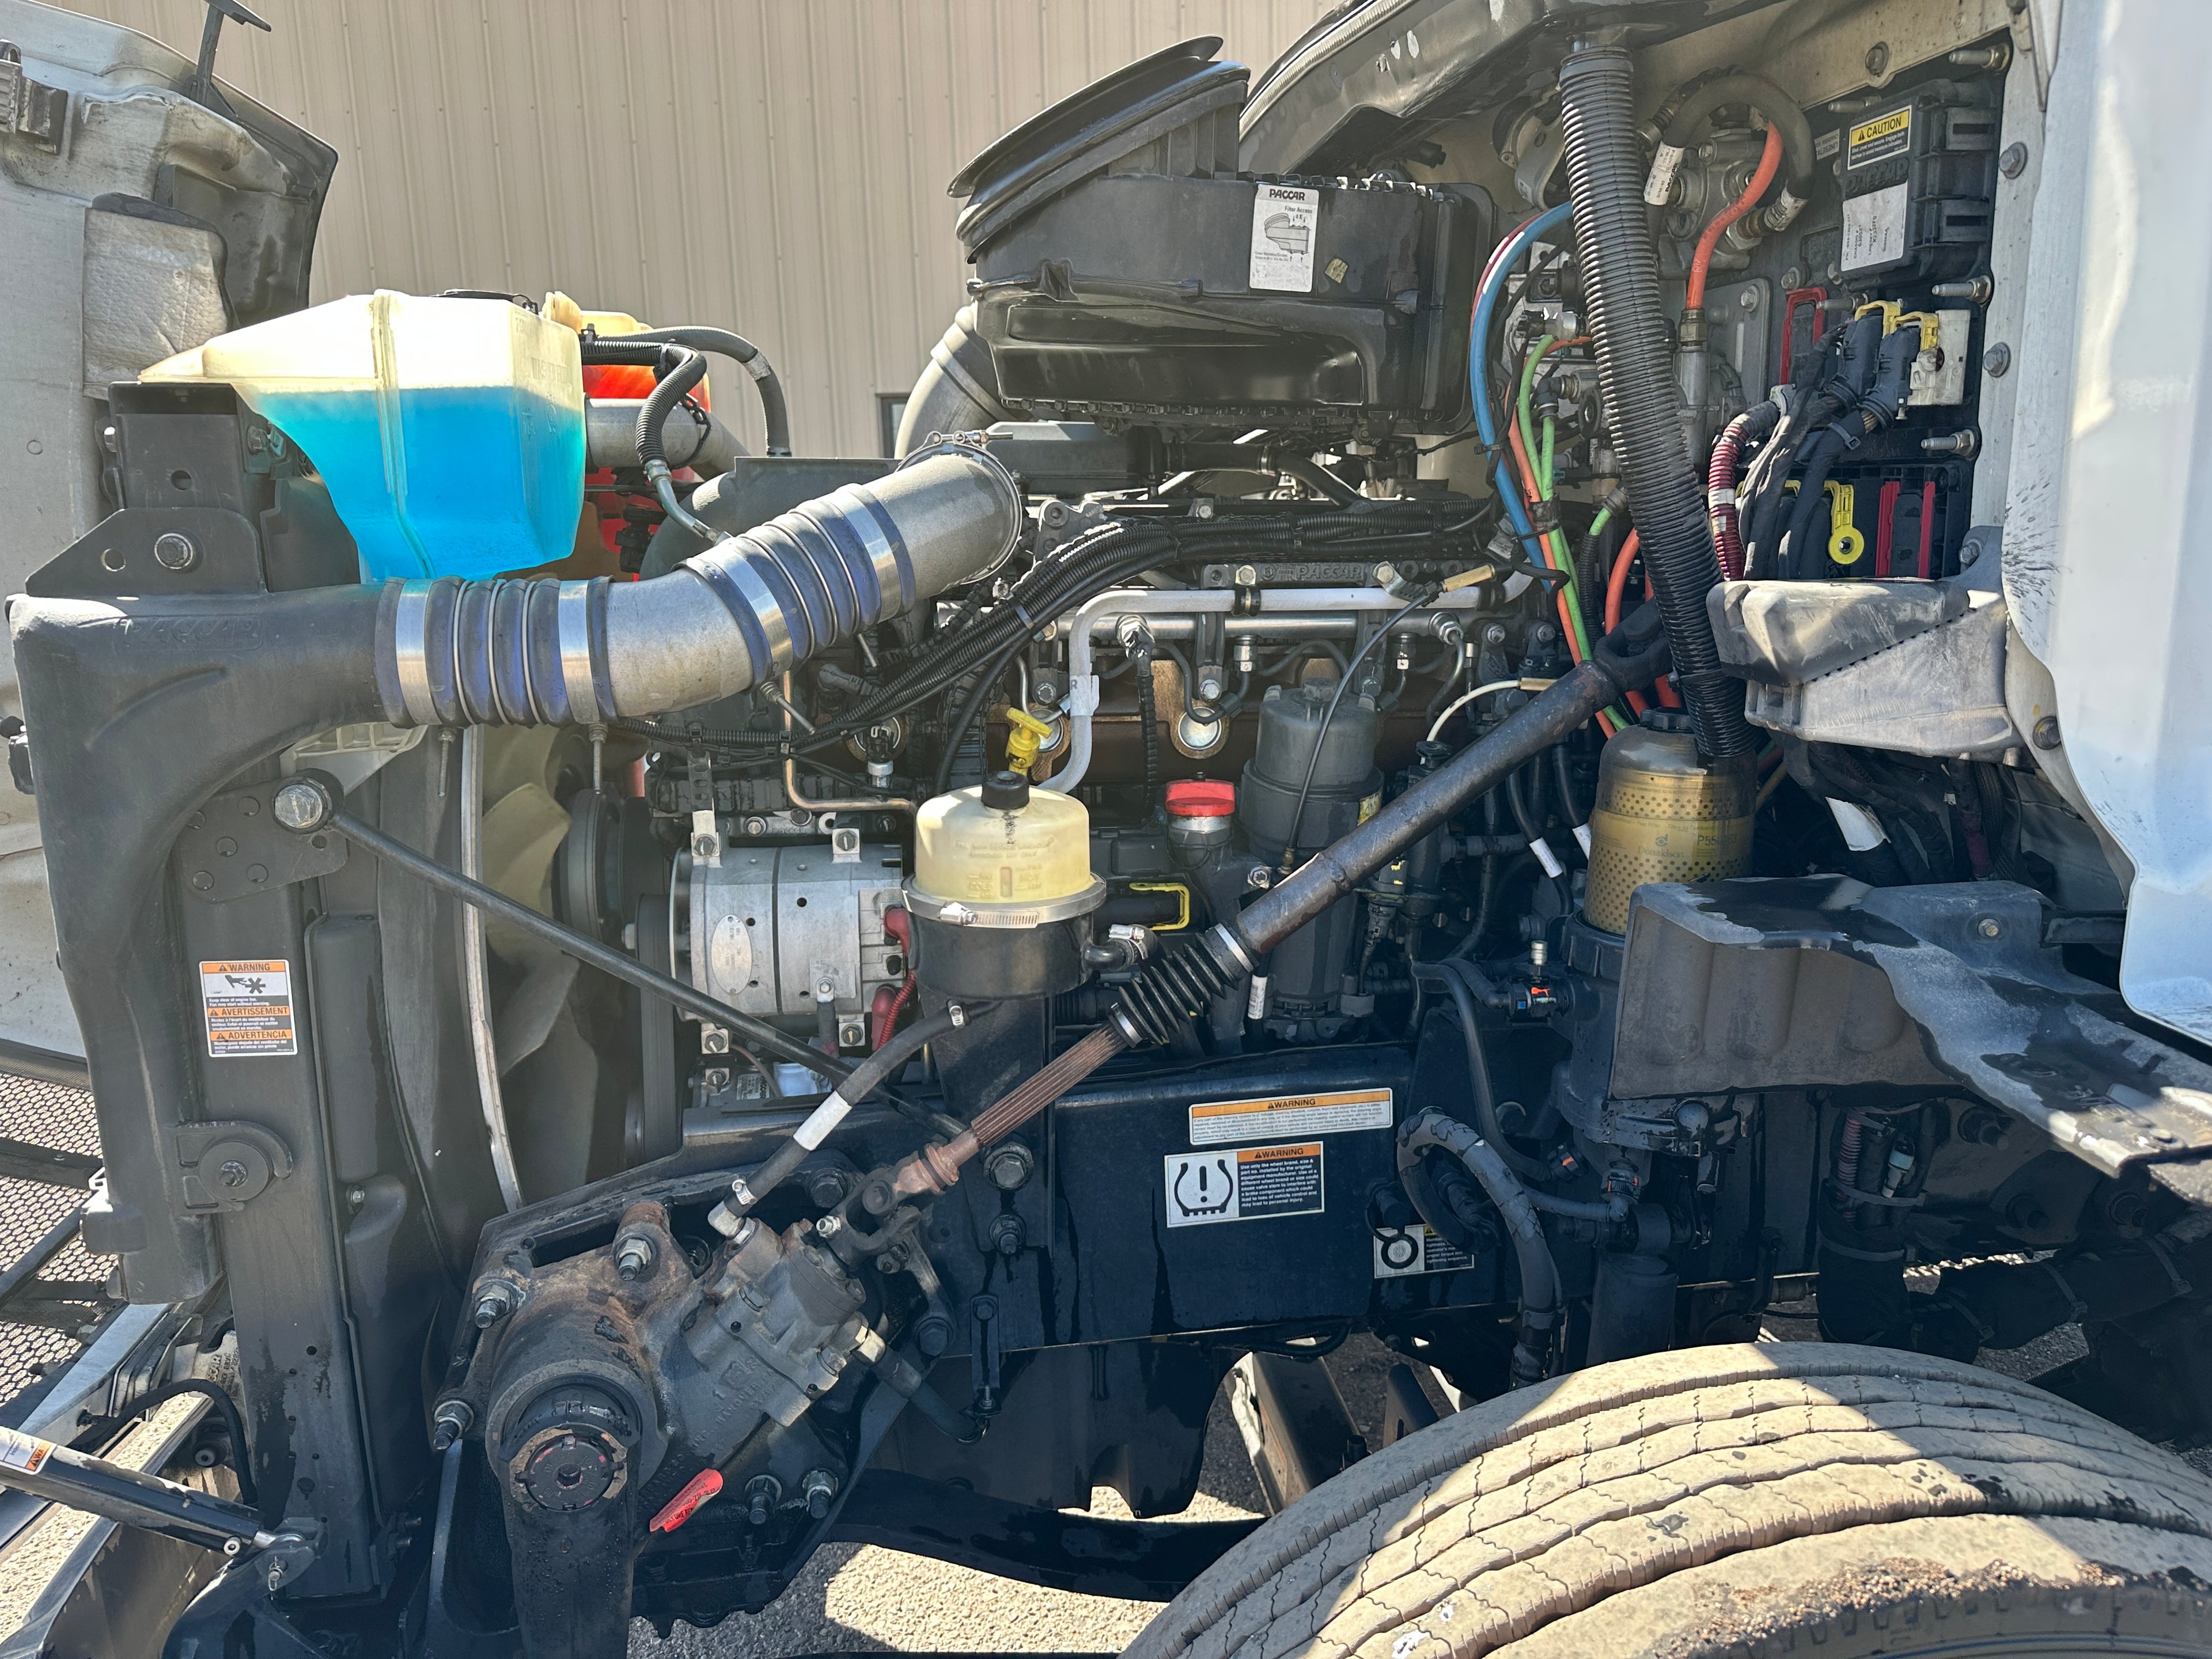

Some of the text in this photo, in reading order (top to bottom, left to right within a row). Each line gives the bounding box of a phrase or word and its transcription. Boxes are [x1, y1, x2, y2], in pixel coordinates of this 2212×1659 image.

[1867, 116, 1902, 138] CAUTION
[1270, 189, 1305, 200] PACCAR
[1297, 564, 1363, 580] PACCAR
[1637, 846, 1684, 858] Donaldson
[969, 881, 994, 890] COLD
[230, 963, 270, 971] WARNING
[221, 1007, 287, 1016] AVERTISSEMENT
[229, 1031, 287, 1039] ADVERTENCIA
[1274, 1098, 1316, 1109] WARNING
[1262, 1148, 1304, 1158] WARNING
[207, 1354, 222, 1381] CCAR
